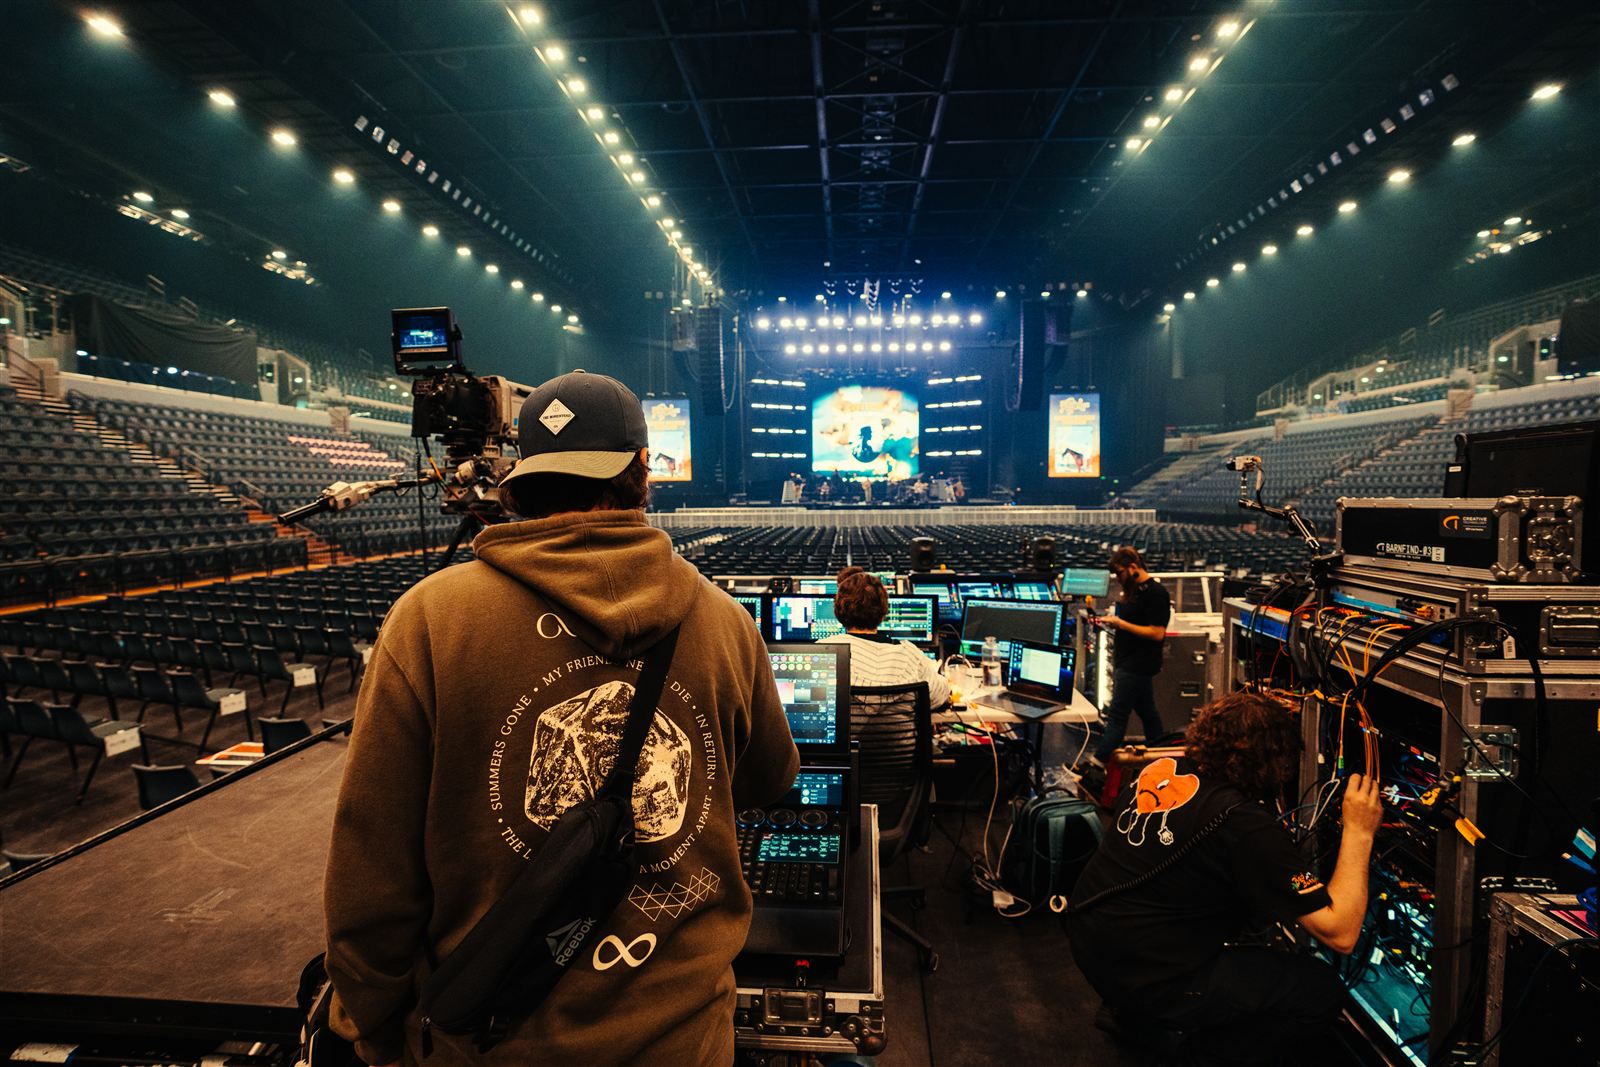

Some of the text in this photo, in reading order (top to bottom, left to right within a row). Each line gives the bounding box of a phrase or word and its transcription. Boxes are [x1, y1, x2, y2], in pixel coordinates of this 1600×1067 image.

[1385, 543, 1432, 556] BARNFIND-03
[542, 666, 563, 687] MY
[566, 655, 619, 673] FRIEN
[670, 680, 692, 703] DIE
[489, 695, 532, 812] SUMMERS GONE
[695, 713, 716, 780] IN RETURN
[501, 826, 526, 853] THE
[639, 794, 712, 874] A MOMENT APART
[555, 916, 598, 967] Reebok
